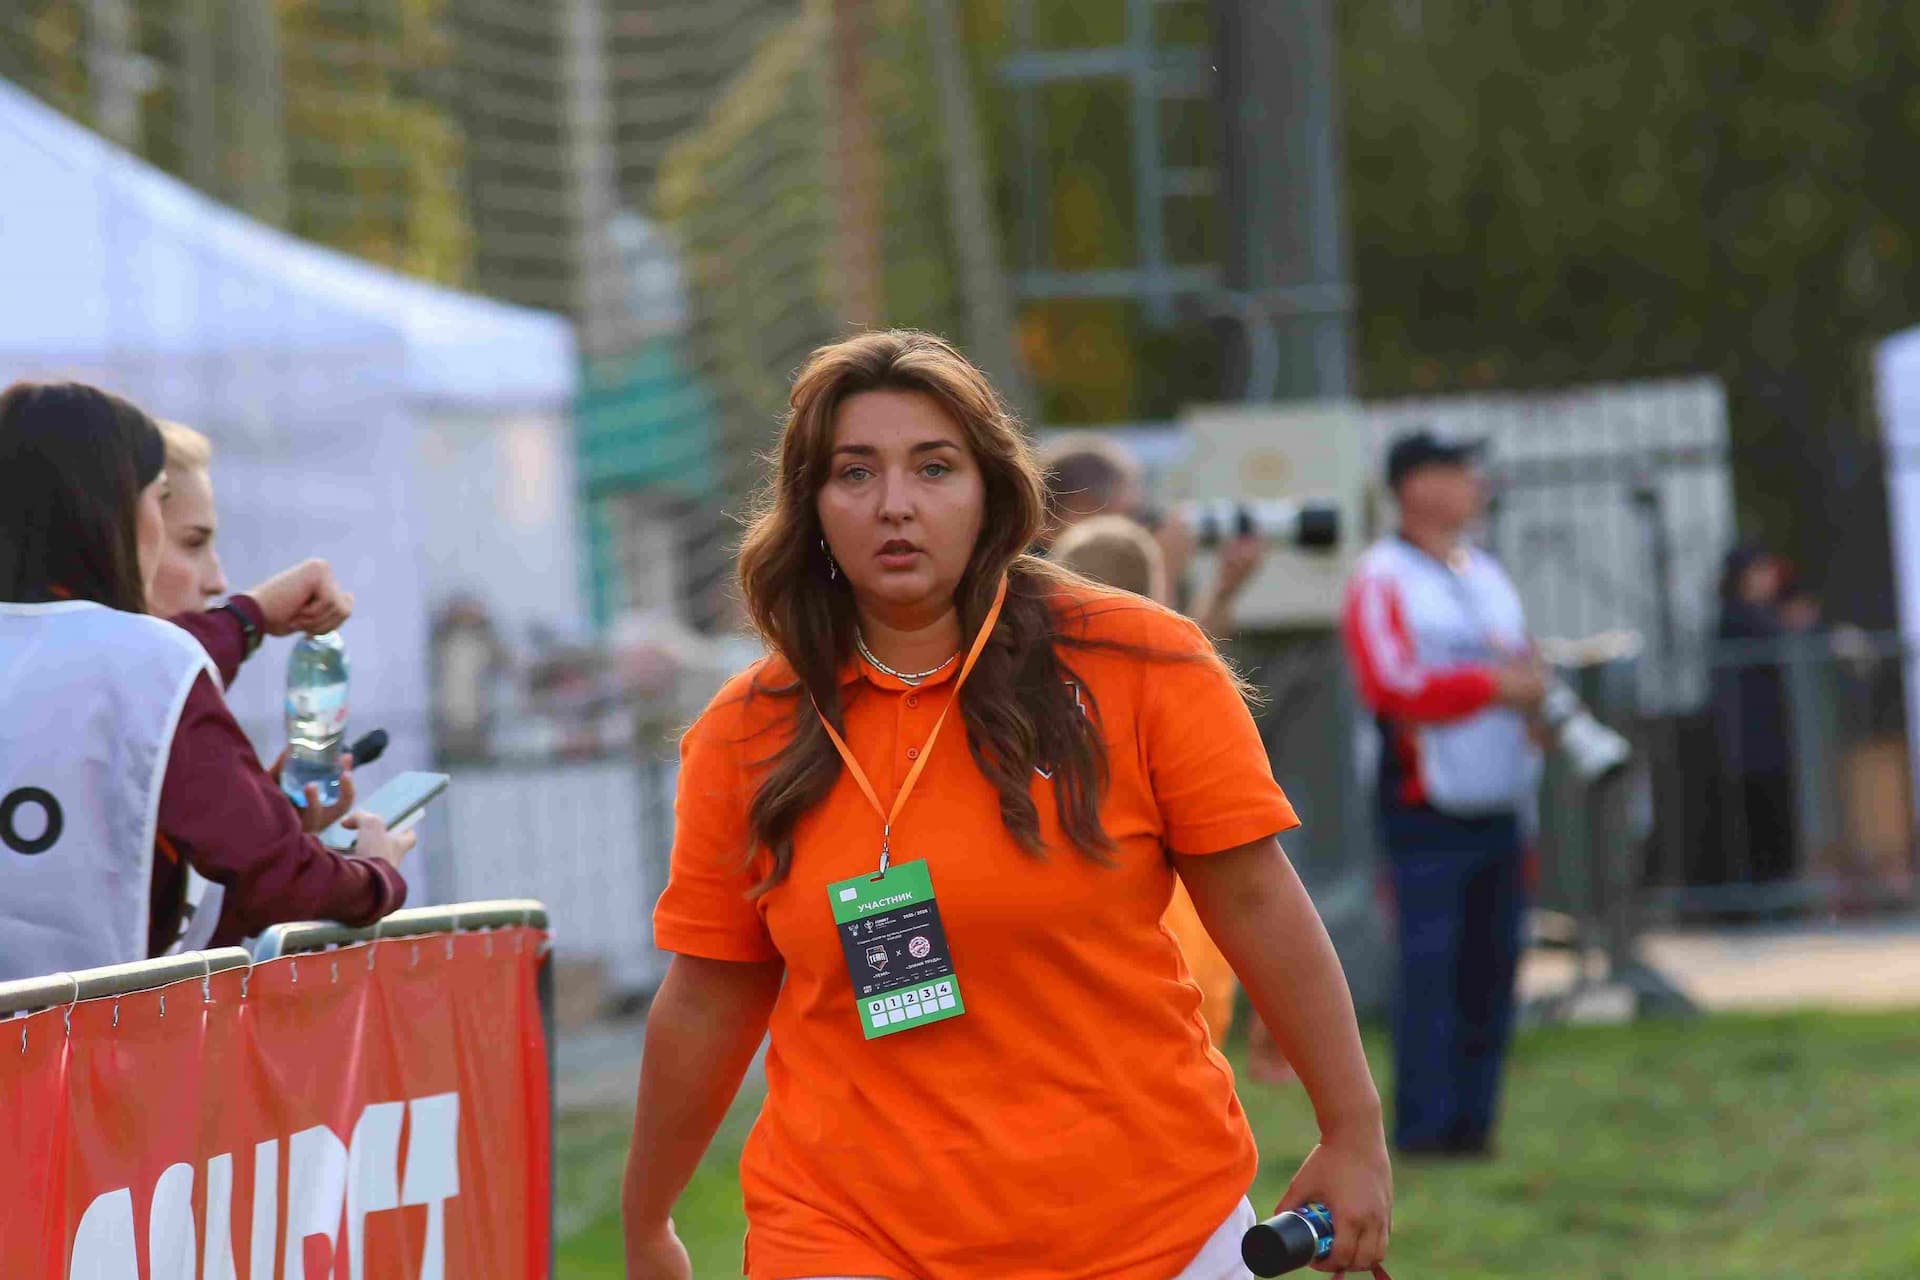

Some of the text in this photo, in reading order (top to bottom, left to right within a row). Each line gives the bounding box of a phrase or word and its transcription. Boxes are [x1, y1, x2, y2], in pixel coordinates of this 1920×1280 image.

[857, 892, 913, 912] УЧАСТНИК
[873, 984, 947, 1011] 0 1 2 3 4
